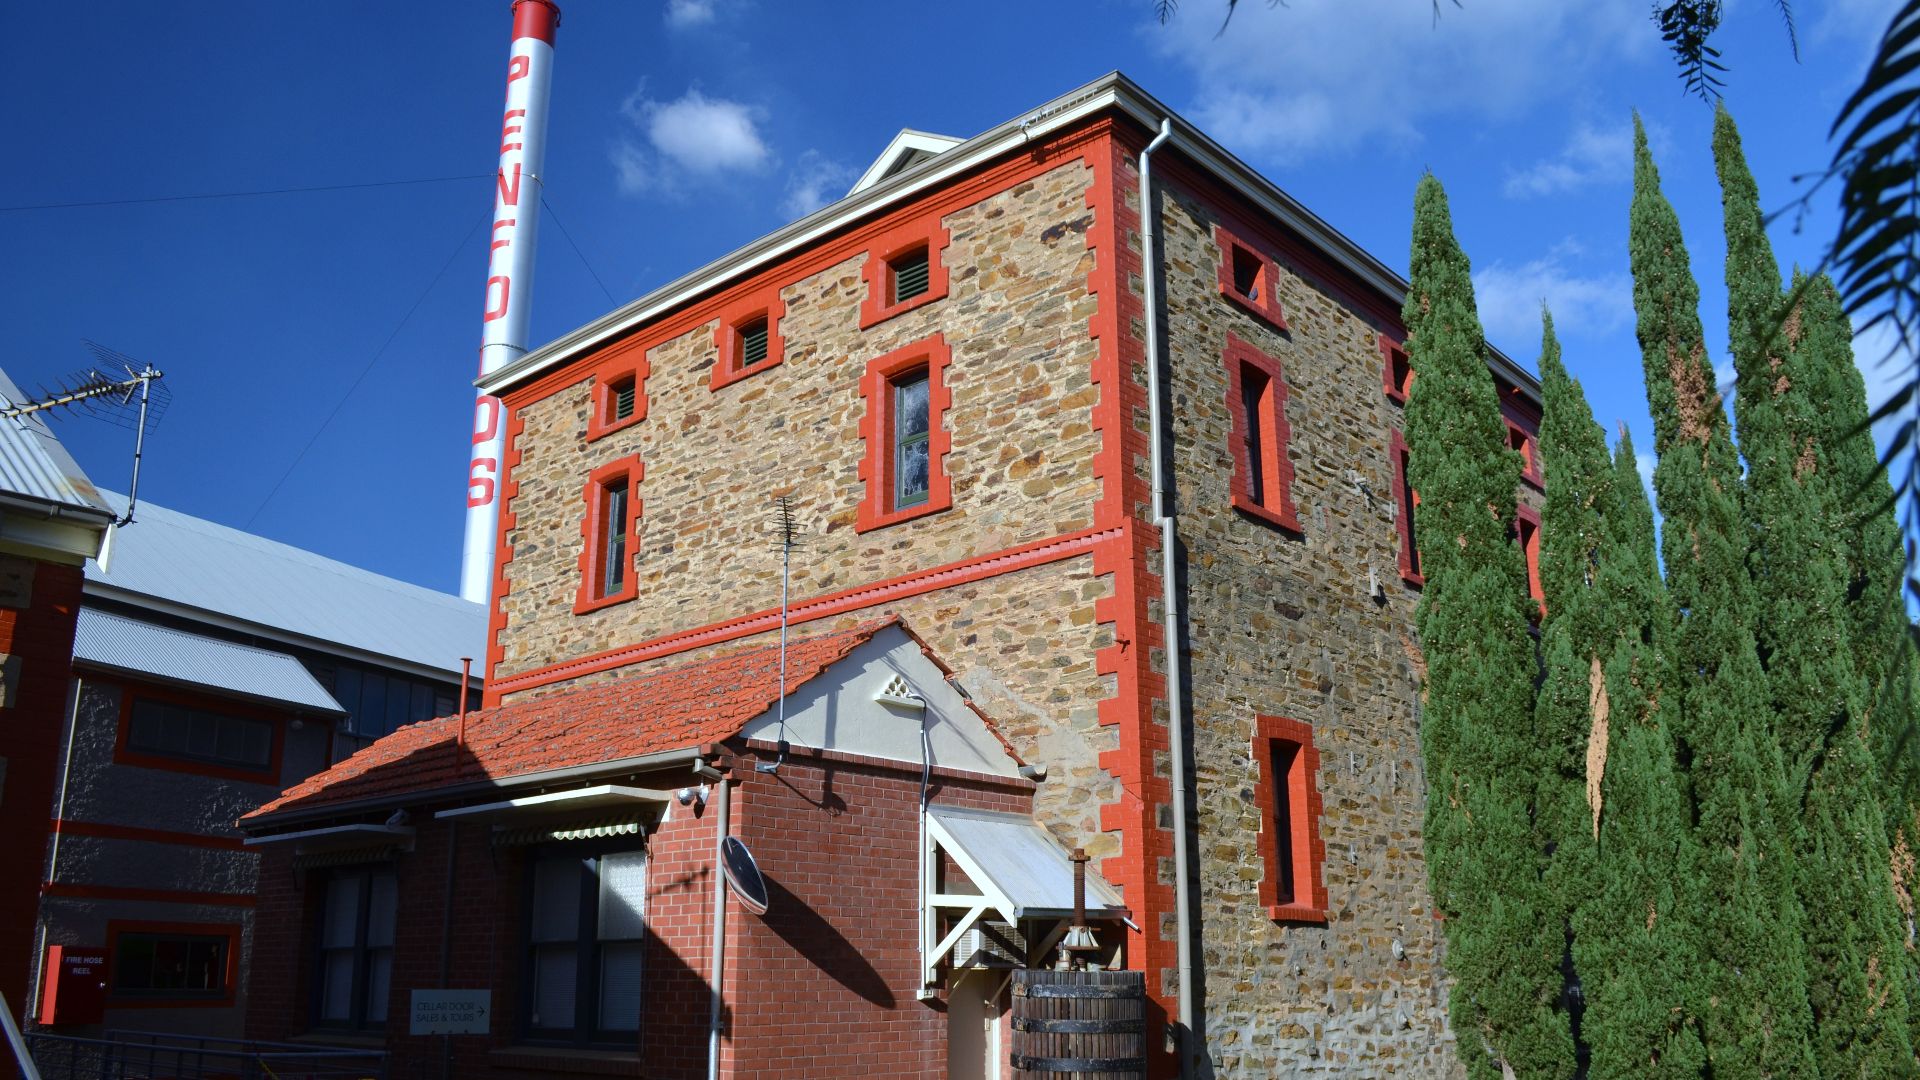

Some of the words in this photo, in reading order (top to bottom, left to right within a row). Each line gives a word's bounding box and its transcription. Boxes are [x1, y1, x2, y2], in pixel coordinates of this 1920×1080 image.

[65, 956, 82, 964] FIRE
[83, 956, 104, 964] HOSE
[72, 967, 92, 975] REEL
[416, 1002, 447, 1011] CELLAR
[448, 1002, 474, 1011] DOOR
[416, 1013, 439, 1022] SALES
[450, 1013, 474, 1022] TOURS
